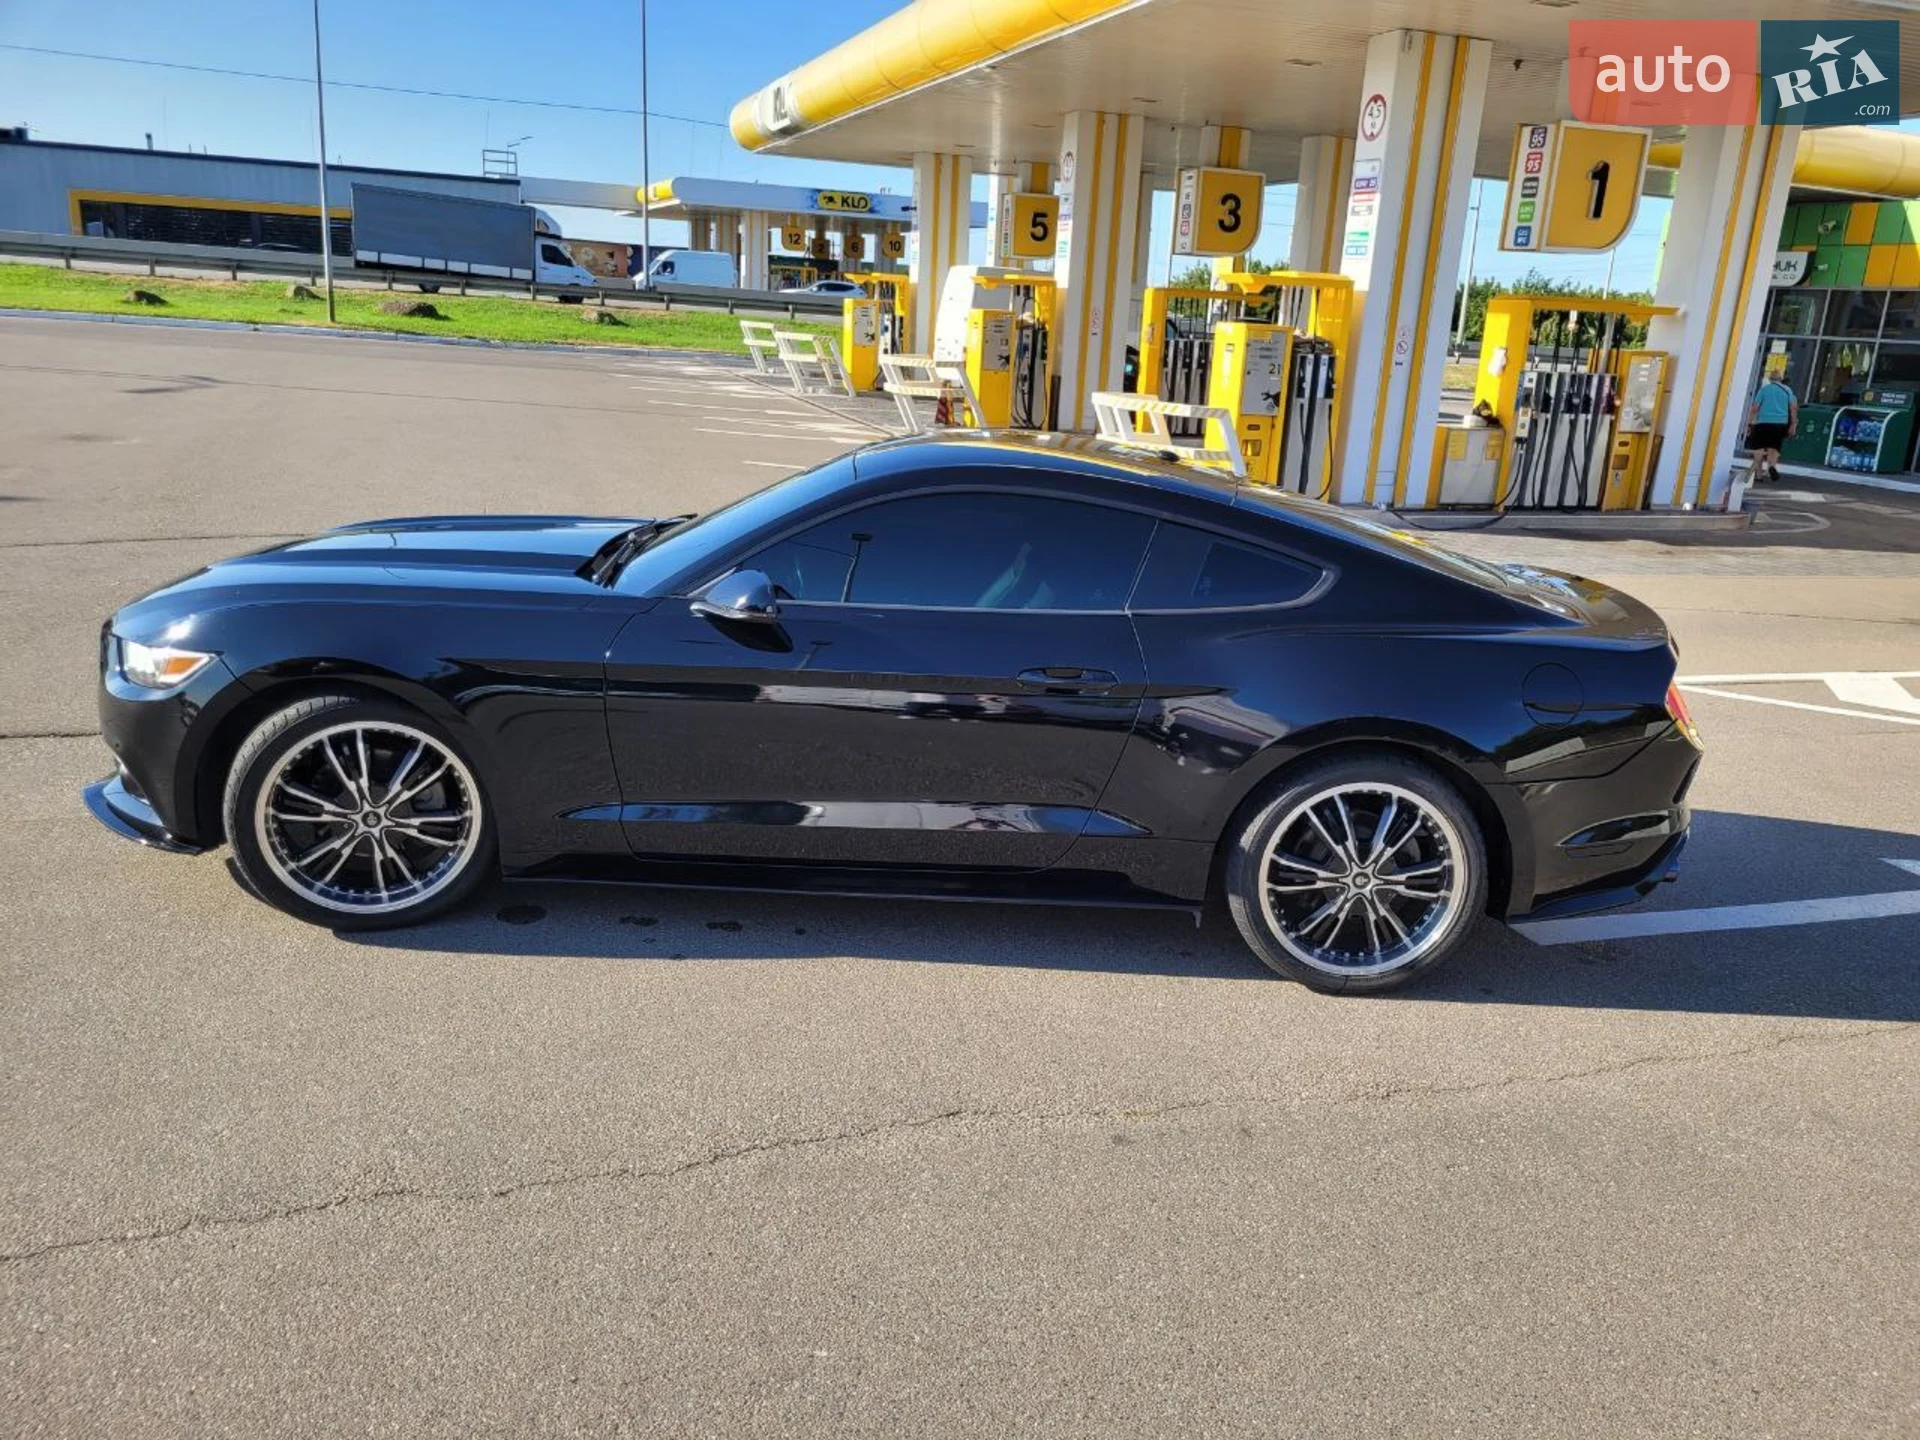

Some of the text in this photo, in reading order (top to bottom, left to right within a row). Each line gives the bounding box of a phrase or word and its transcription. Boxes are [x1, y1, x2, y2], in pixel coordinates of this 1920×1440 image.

[1531, 132, 1546, 148] 95
[1527, 159, 1542, 172] 95
[1586, 160, 1611, 219] 1
[841, 195, 868, 209] KLO
[1217, 192, 1242, 233] 3
[1030, 211, 1049, 242] 5
[788, 233, 801, 245] 12
[851, 242, 859, 253] 6
[888, 241, 901, 252] 10
